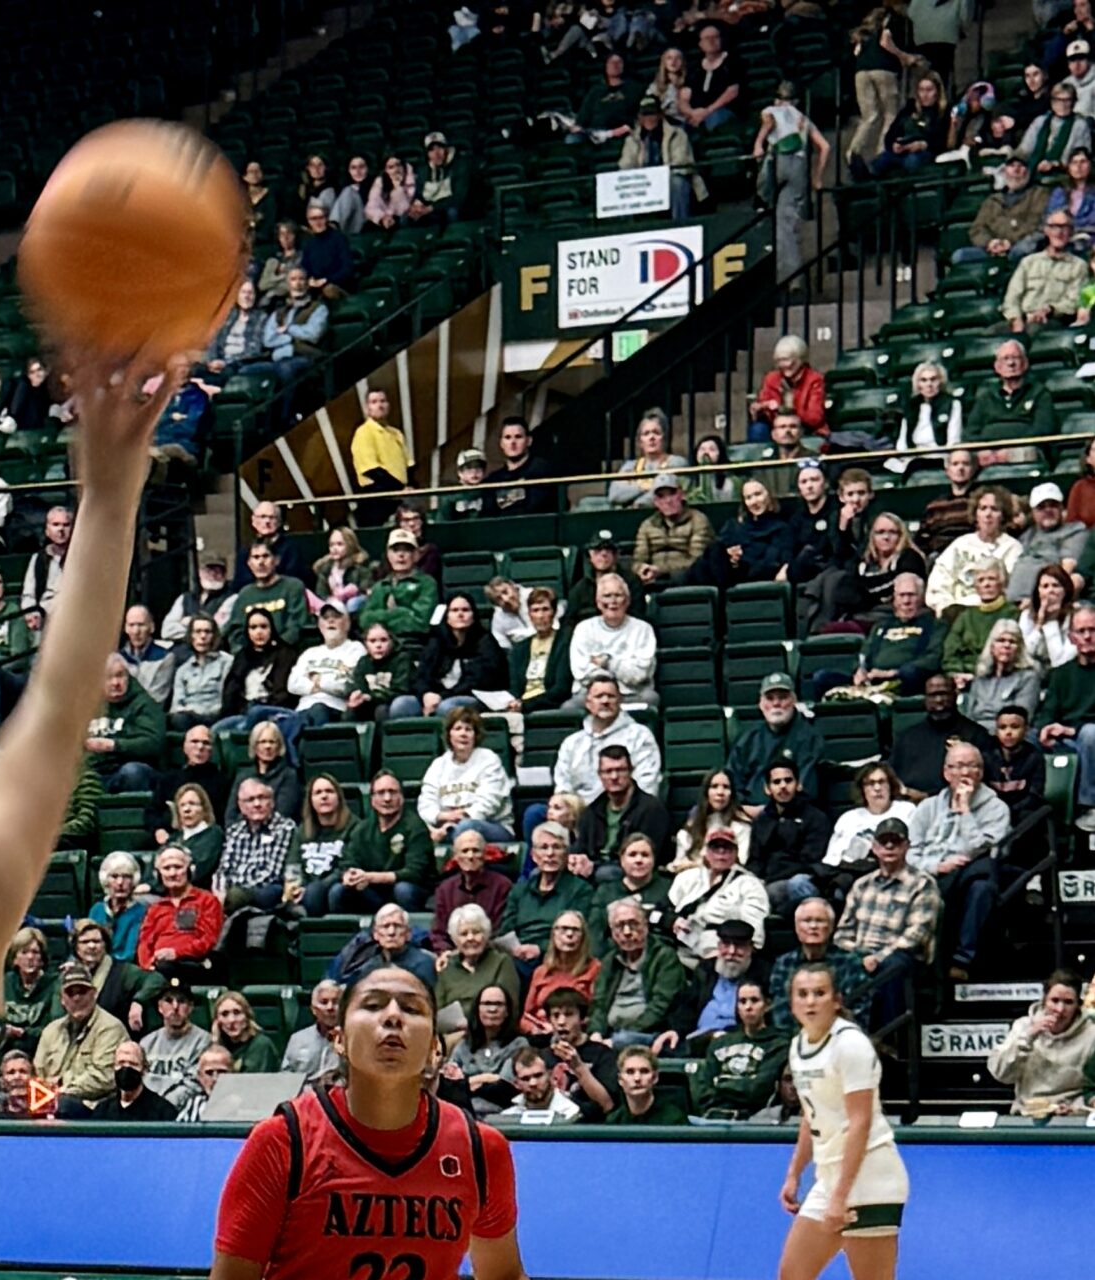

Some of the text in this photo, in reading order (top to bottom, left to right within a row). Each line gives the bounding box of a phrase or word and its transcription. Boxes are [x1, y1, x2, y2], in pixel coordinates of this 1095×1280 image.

[567, 248, 620, 270] STAND
[520, 265, 550, 311] F
[567, 277, 599, 297] FOR
[322, 1191, 464, 1242] AZTECS
